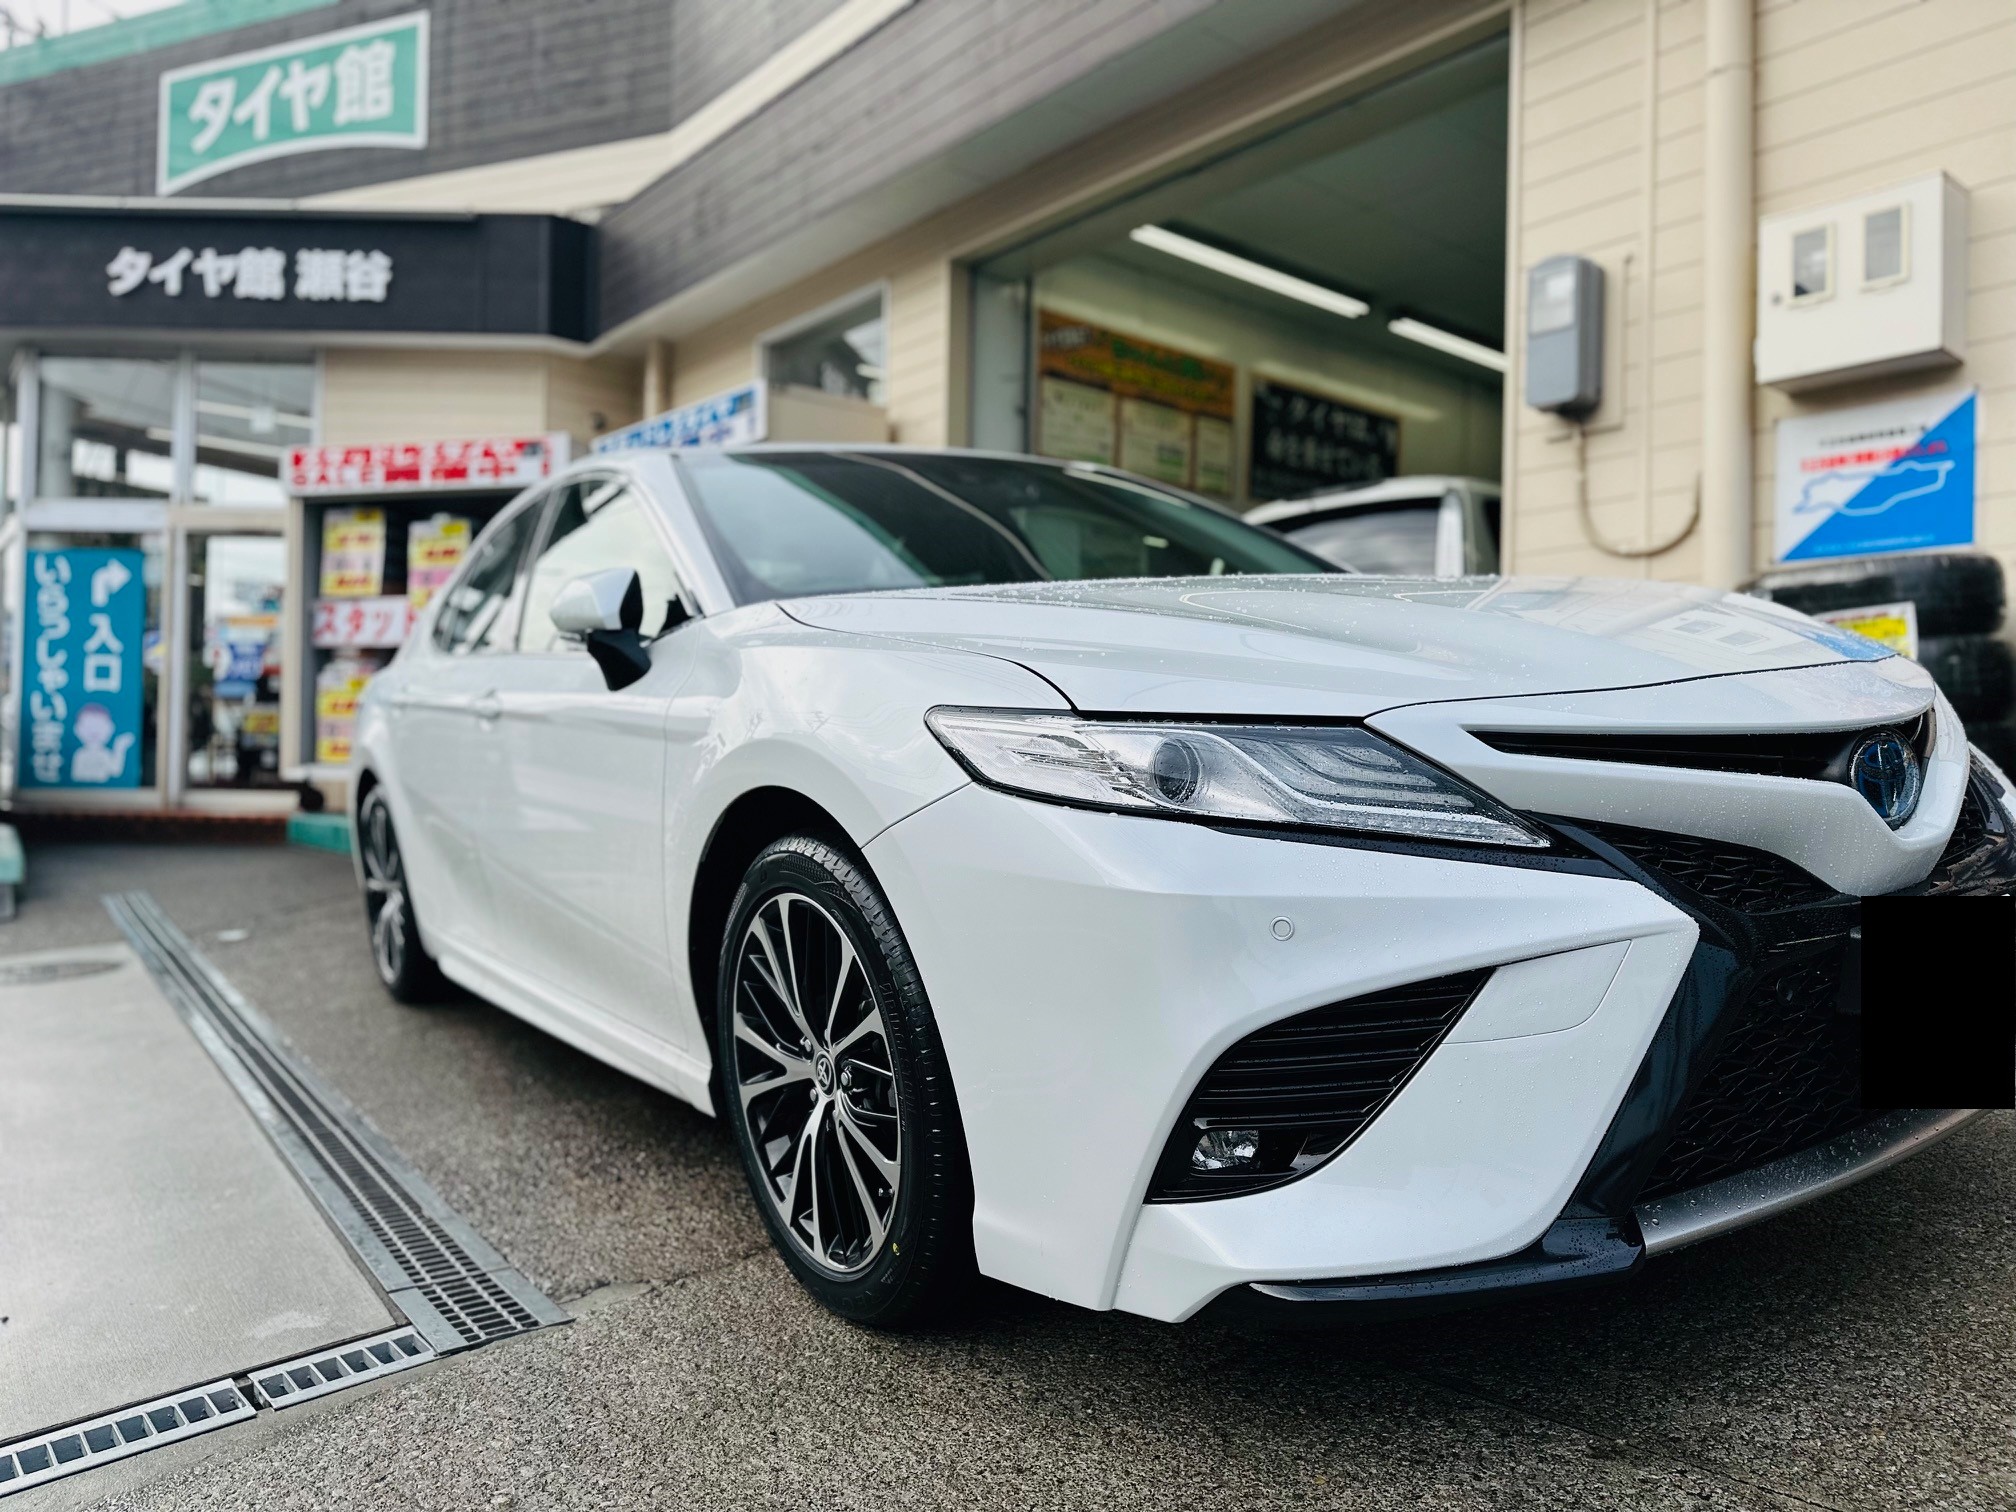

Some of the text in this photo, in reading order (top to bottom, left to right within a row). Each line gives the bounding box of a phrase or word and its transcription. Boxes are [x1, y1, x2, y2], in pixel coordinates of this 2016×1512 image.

[188, 38, 395, 154] タイヤ館
[105, 246, 286, 301] タイヤ館
[30, 553, 72, 783] いらっしゃいませ
[83, 613, 124, 693] 入口
